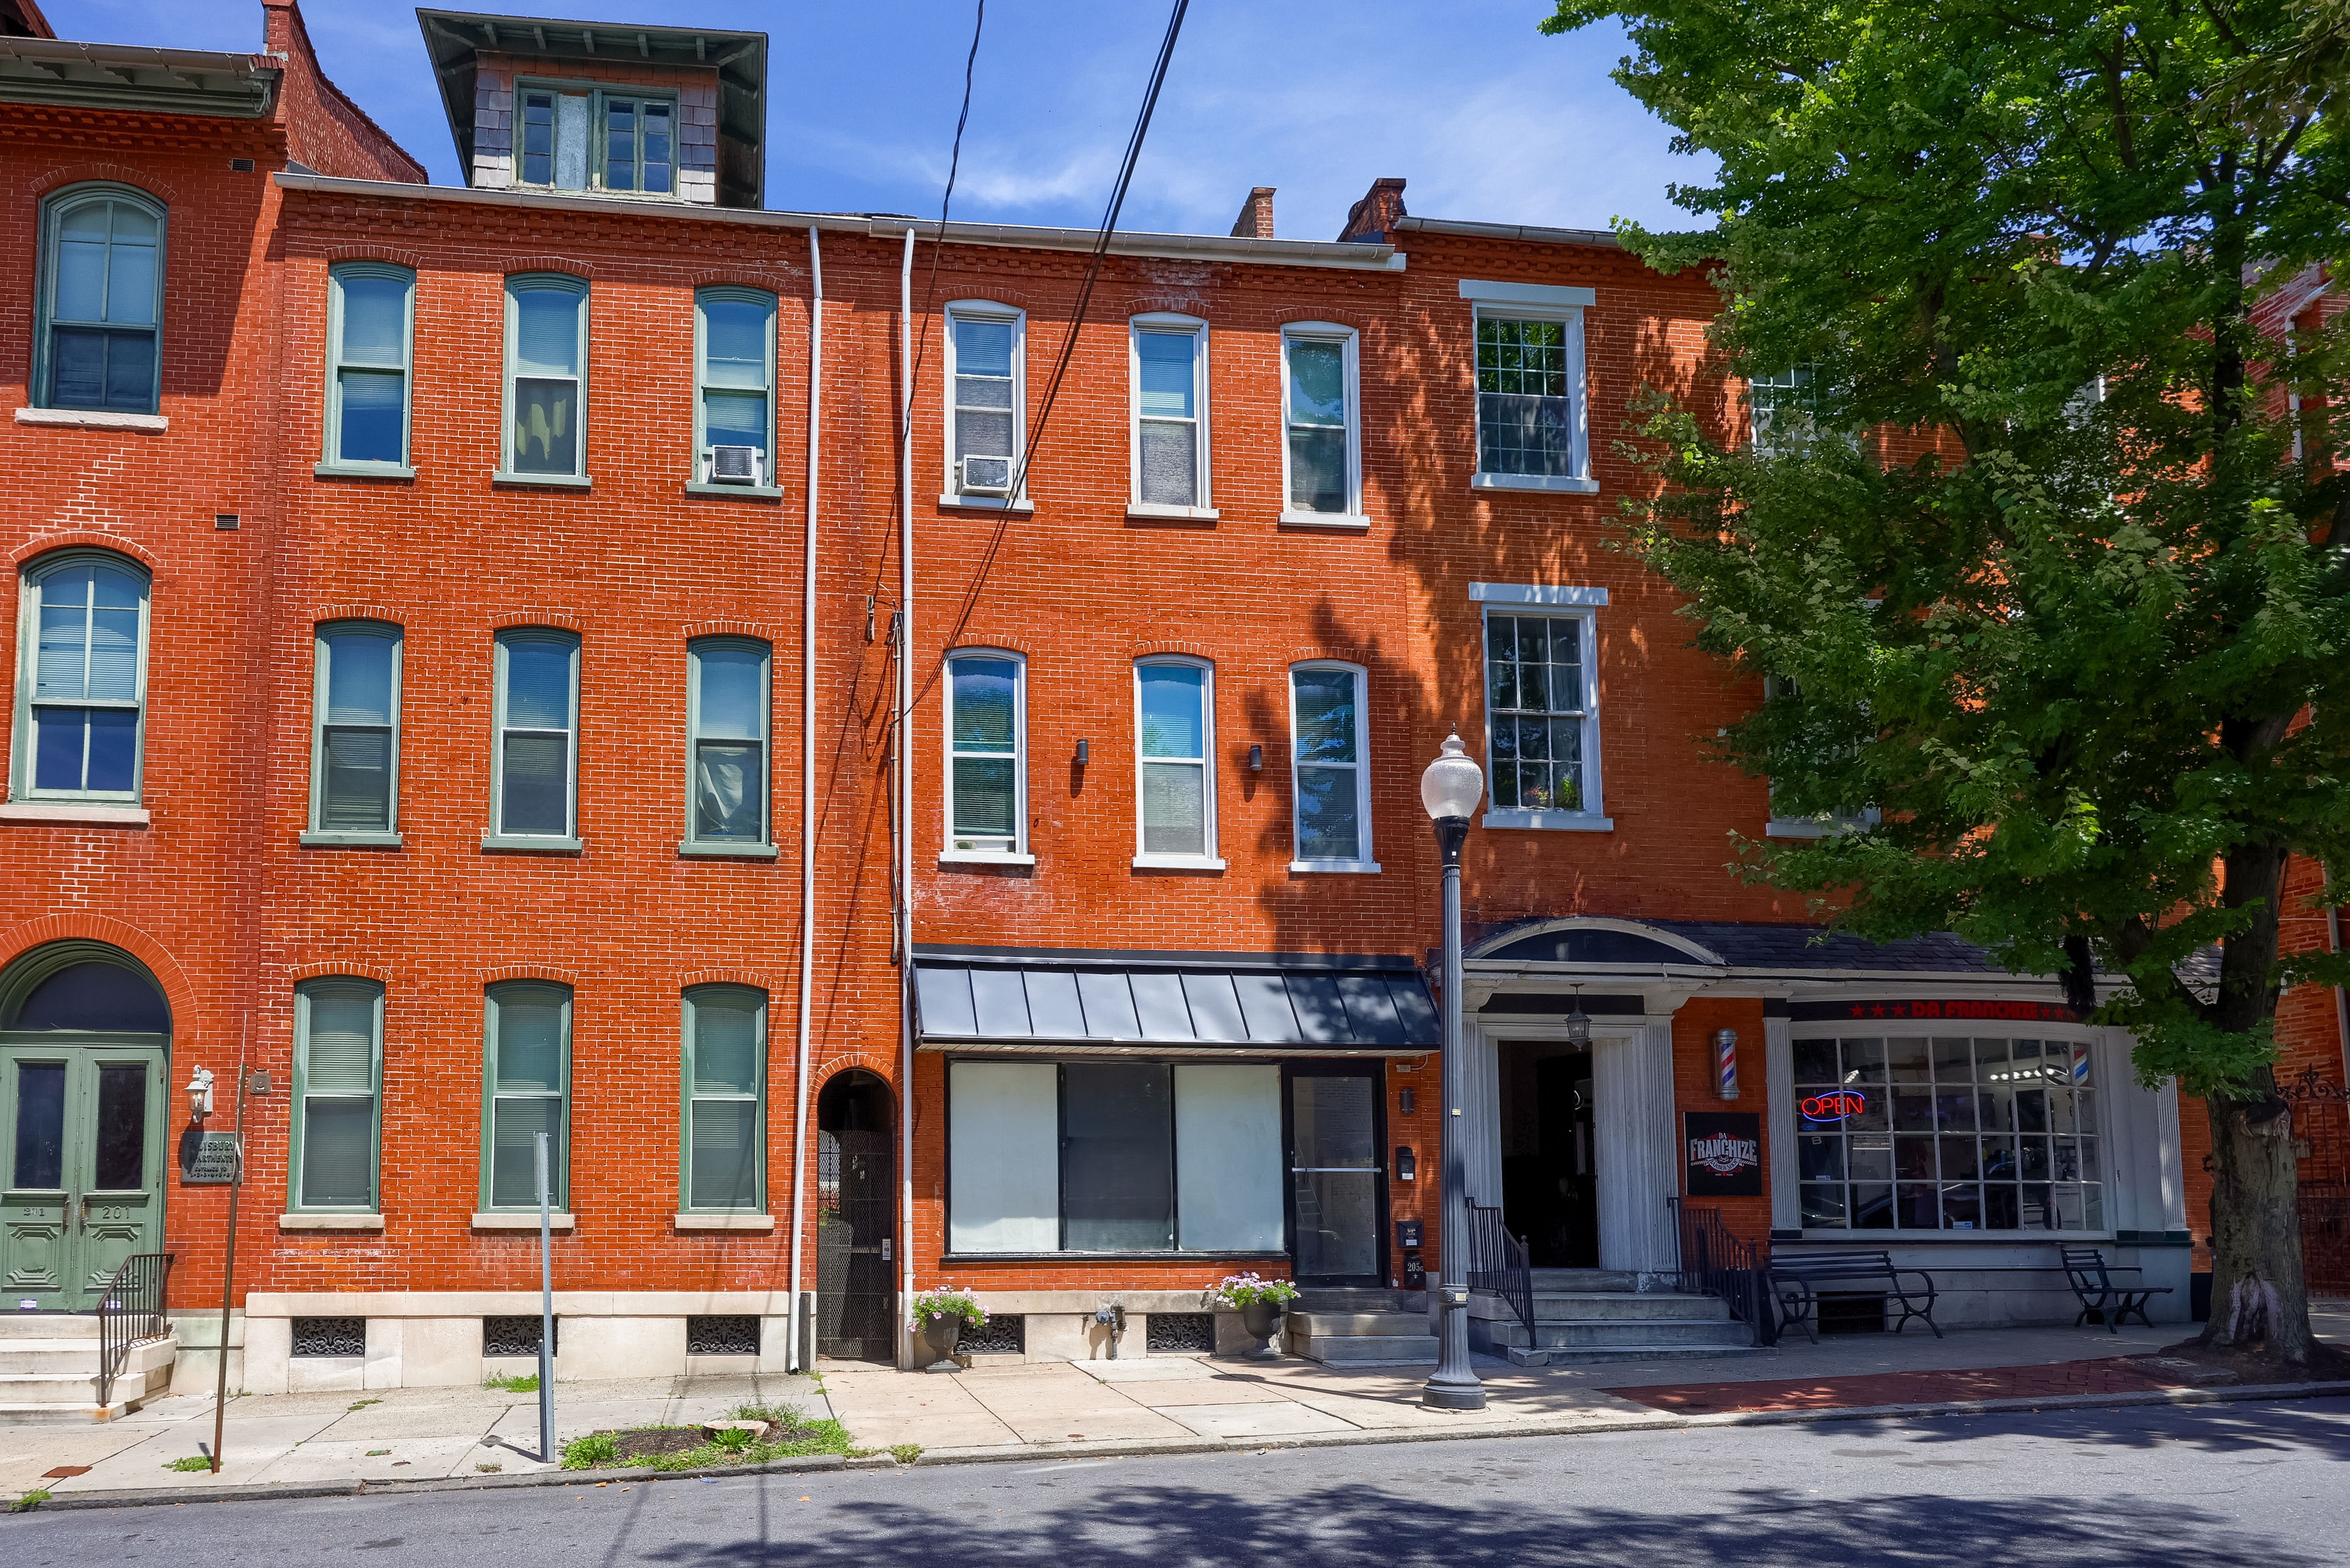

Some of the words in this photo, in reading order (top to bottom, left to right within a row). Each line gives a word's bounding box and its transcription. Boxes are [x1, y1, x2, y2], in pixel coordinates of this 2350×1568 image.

[1912, 1002, 1942, 1017] DA
[1946, 1002, 2038, 1019] FRANCHIZE
[1802, 1097, 1863, 1115] OPEN
[1690, 1138, 1757, 1162] FRANCHIZE
[1709, 1159, 1726, 1170] BARBER
[1727, 1159, 1738, 1170] SHOP
[23, 1207, 45, 1217] 201
[102, 1206, 130, 1219] 201
